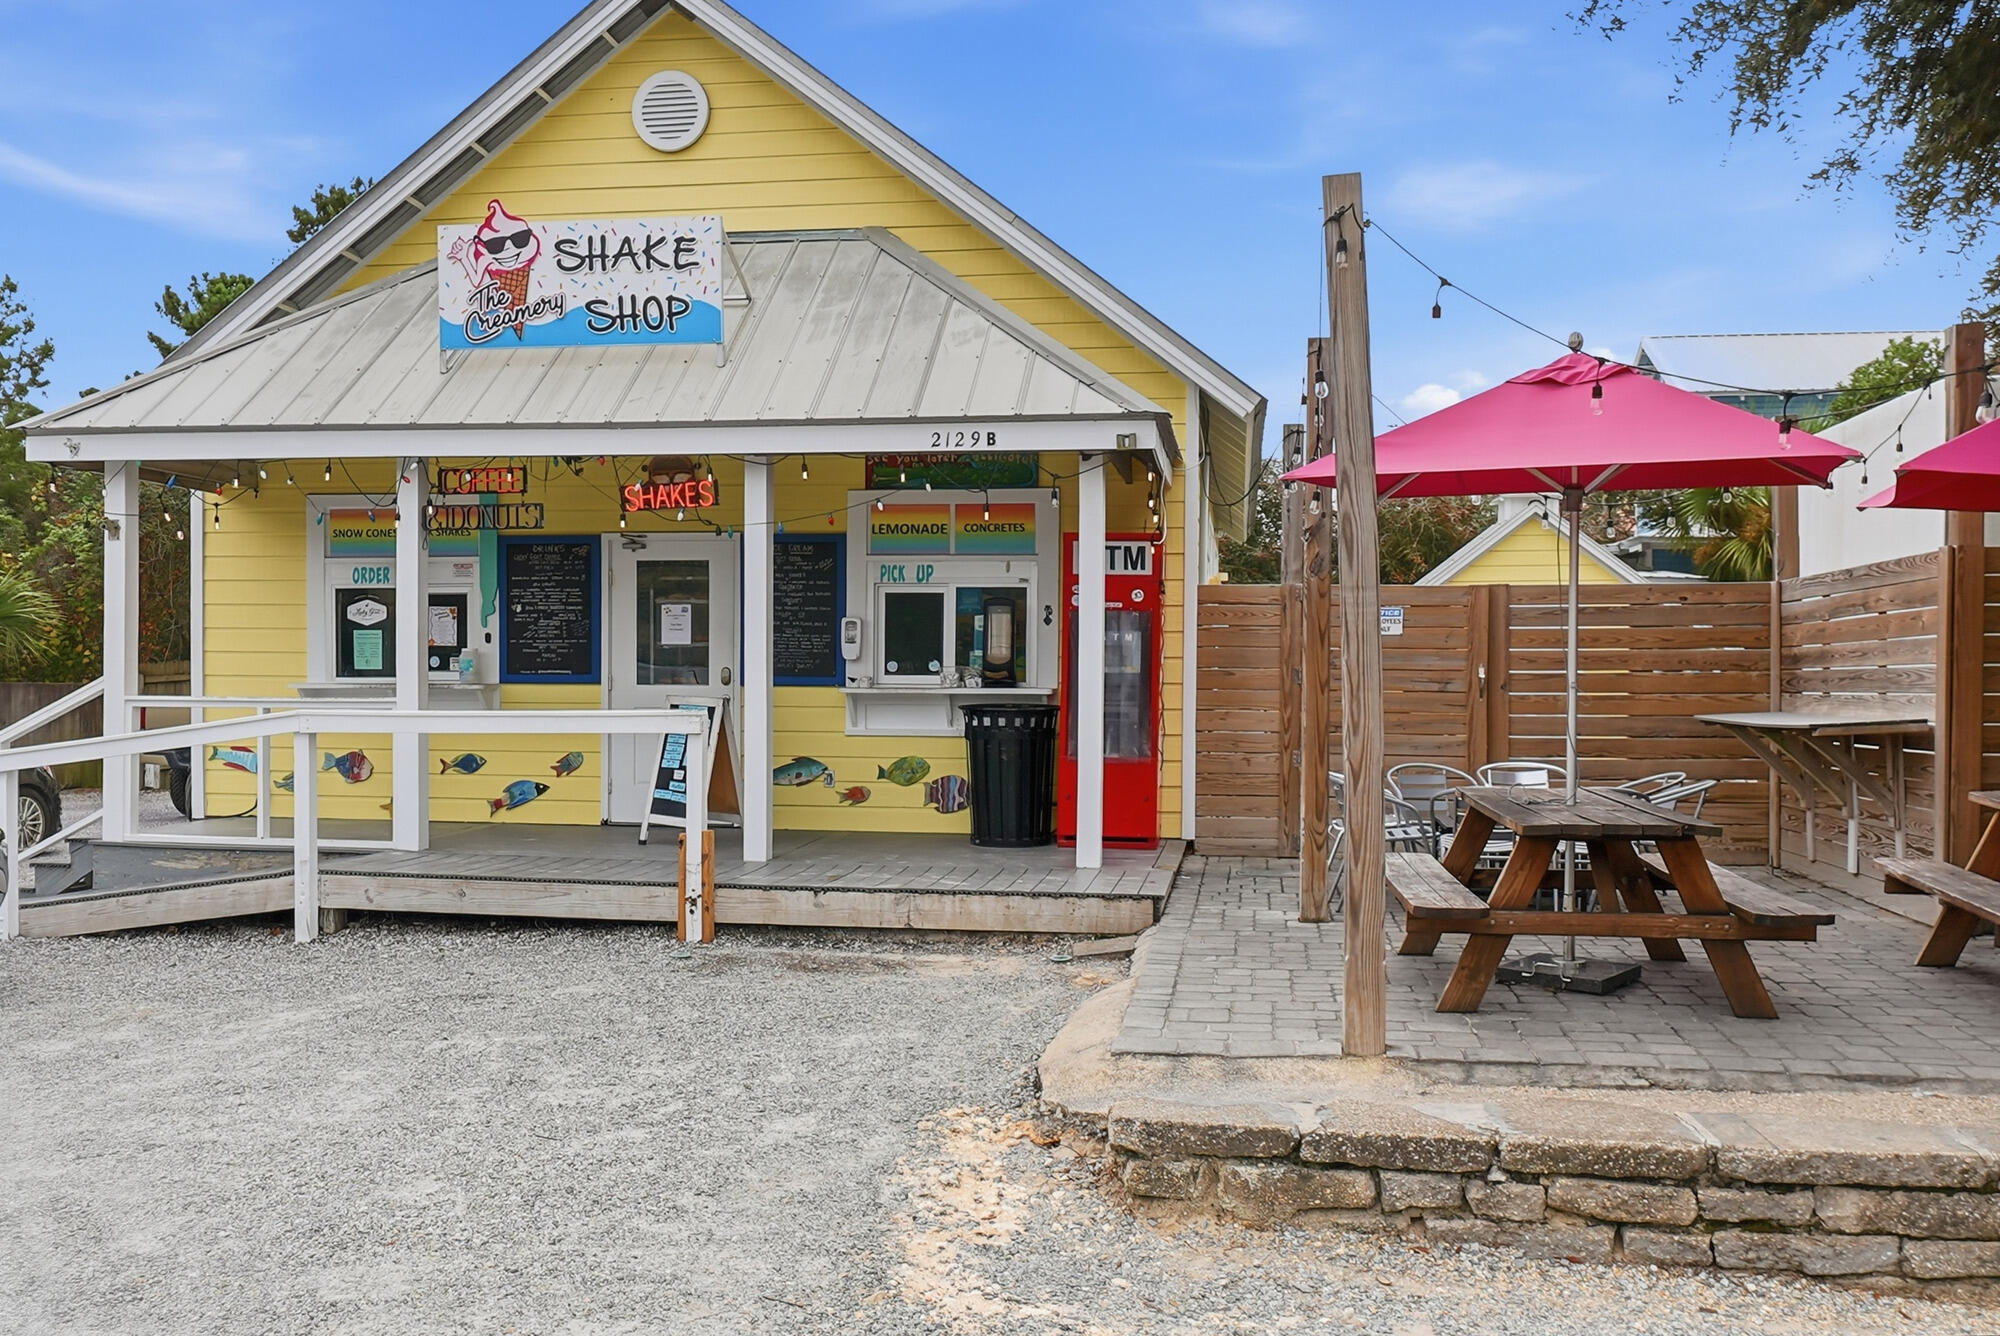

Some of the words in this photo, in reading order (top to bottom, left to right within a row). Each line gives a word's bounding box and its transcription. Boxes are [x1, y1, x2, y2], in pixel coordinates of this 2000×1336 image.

[554, 234, 700, 272] SHAKE
[468, 281, 511, 310] The
[464, 291, 566, 343] Creamery
[585, 294, 691, 333] SHOP
[896, 455, 918, 465] you
[442, 468, 521, 494] COFFEE
[624, 480, 714, 513] SHAKES
[448, 505, 540, 530] DONUTS
[872, 523, 948, 535] LEMONADE
[964, 522, 1025, 533] CONCRETES
[333, 528, 363, 538] SNOW
[1105, 545, 1146, 571] TM
[352, 566, 391, 584] ORDER
[880, 564, 905, 583] PICK
[916, 564, 934, 584] UP
